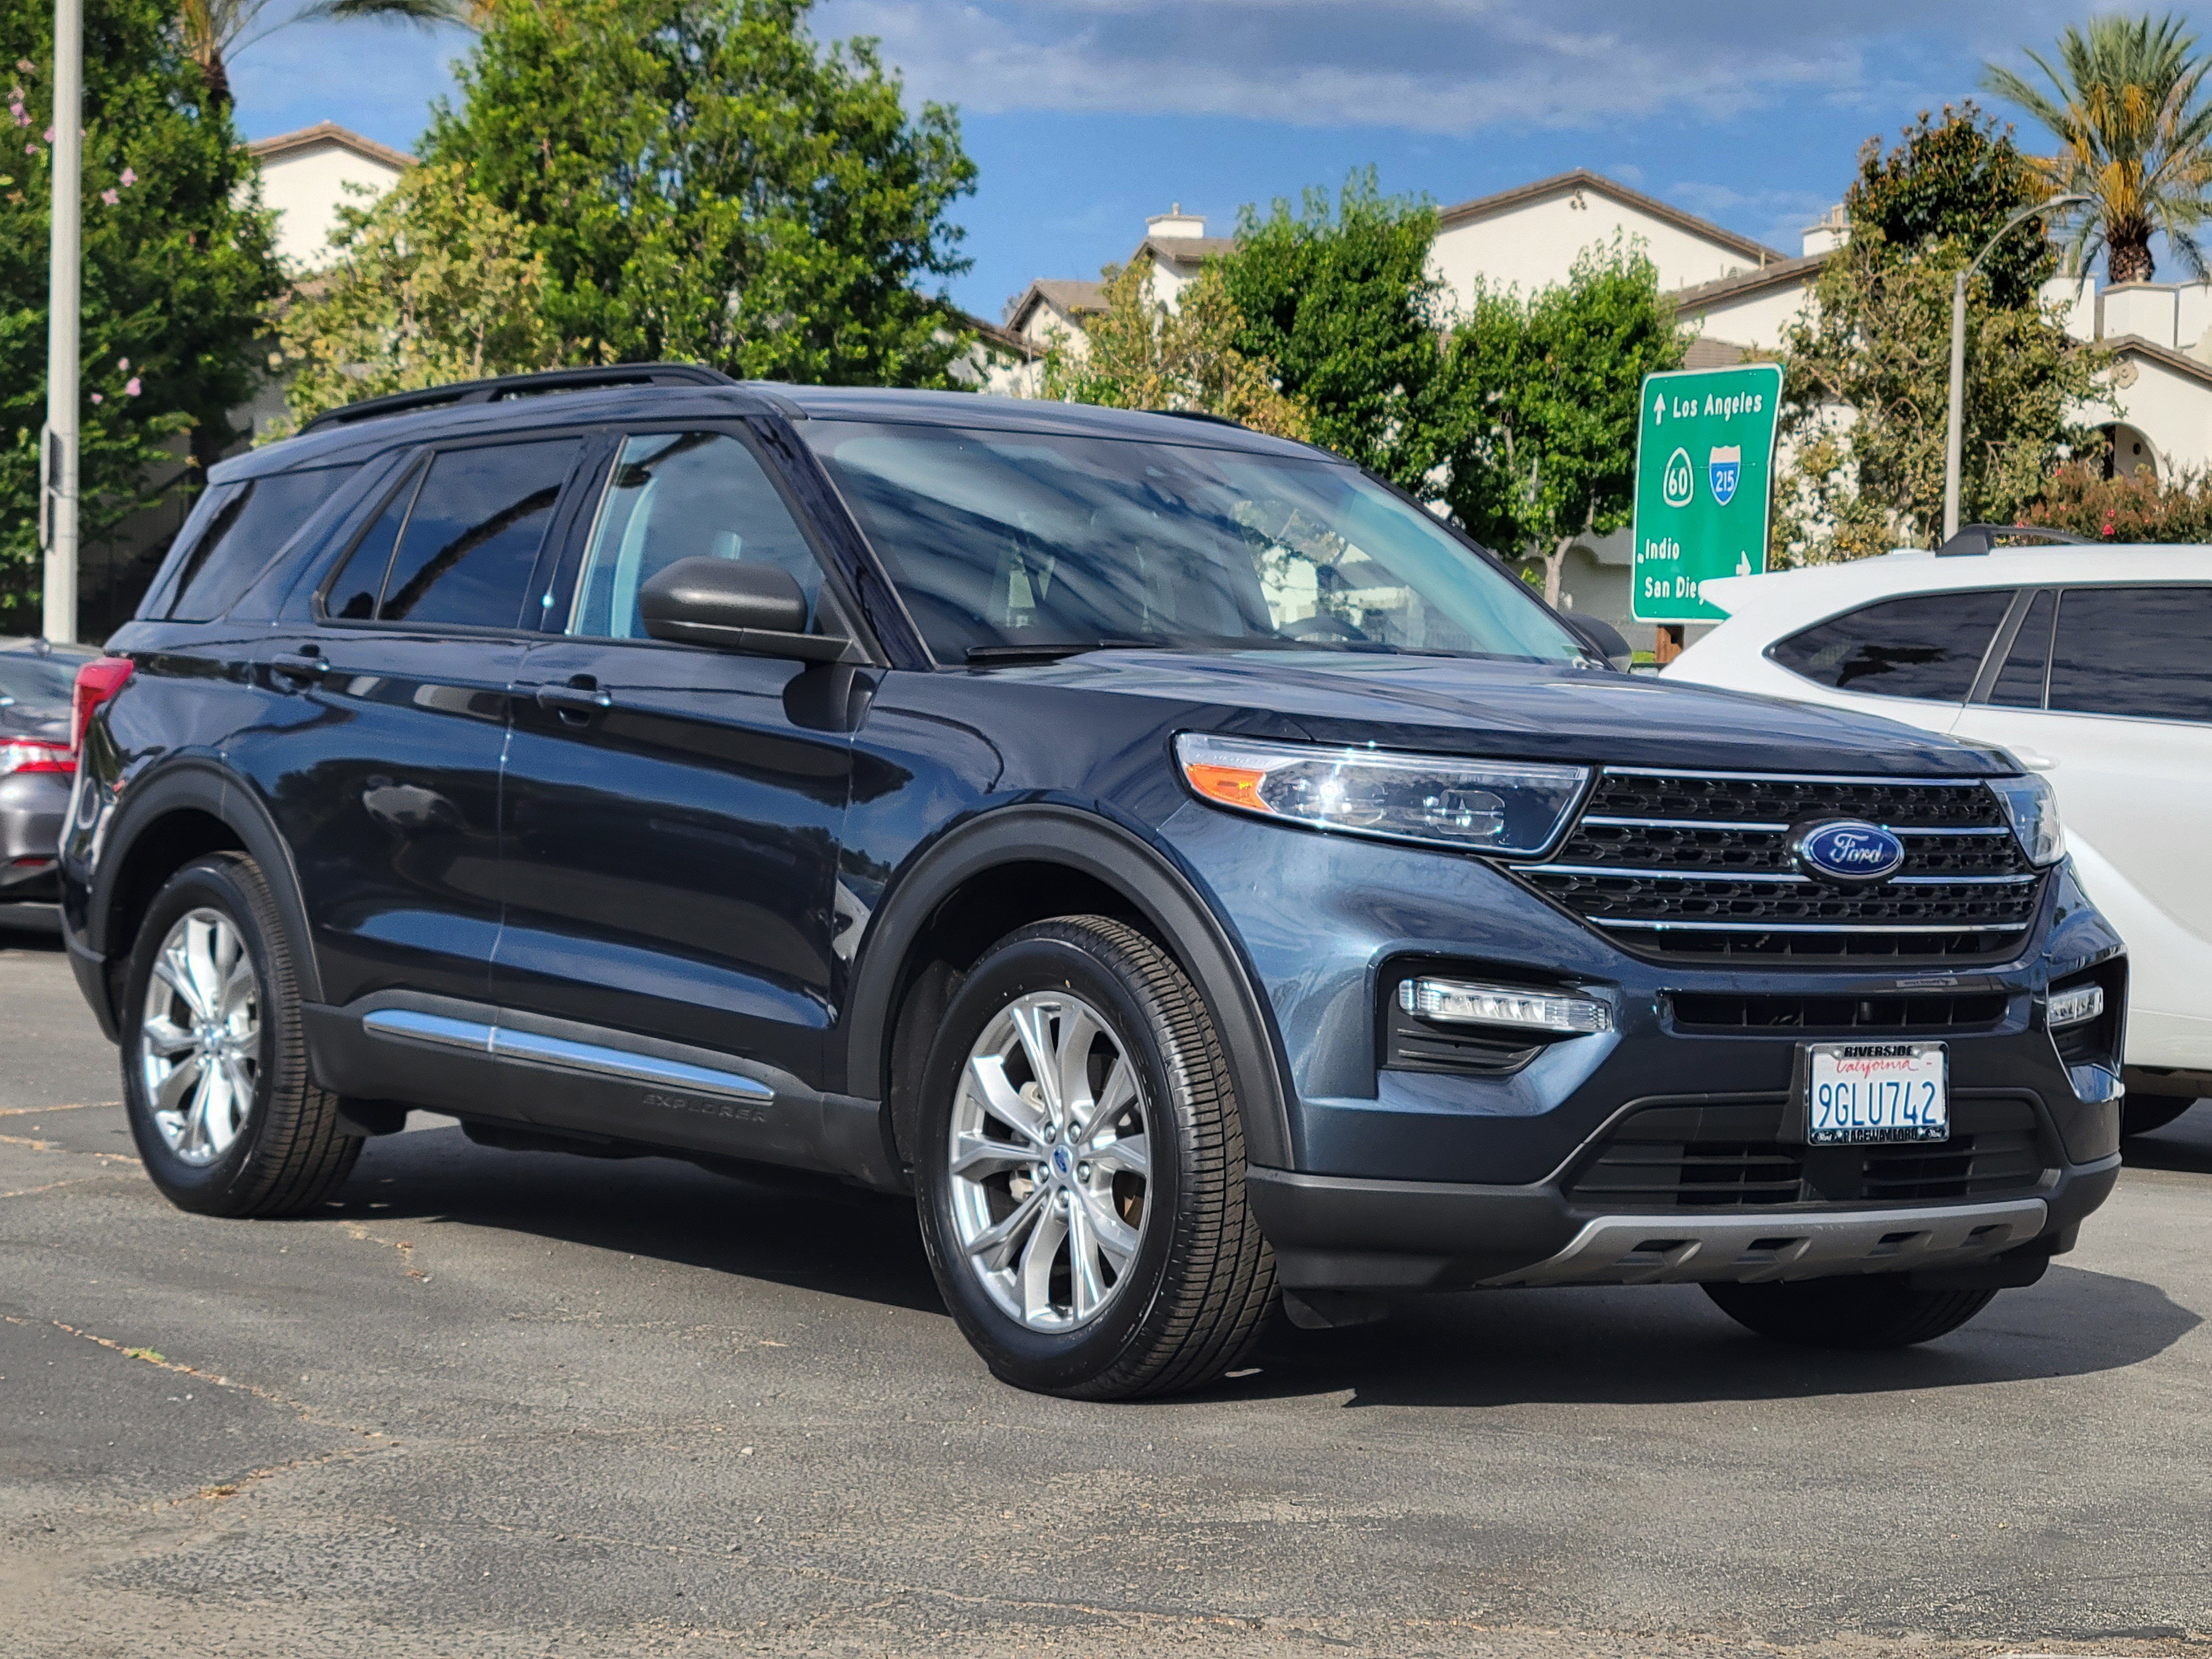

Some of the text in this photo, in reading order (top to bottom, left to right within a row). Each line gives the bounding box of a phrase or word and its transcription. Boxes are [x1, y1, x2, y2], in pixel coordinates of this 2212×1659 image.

[1673, 391, 1762, 421] Los Angeles
[1668, 467, 1688, 496] 60
[1716, 470, 1735, 492] 215
[1645, 537, 1680, 560] Indio
[1645, 576, 1705, 606] San Die
[1830, 833, 1883, 865] Ford
[1844, 1046, 1913, 1057] RIVERSIDE
[1836, 1059, 1918, 1078] California
[643, 1094, 766, 1122] EXPLORER
[1818, 1081, 1937, 1127] 9GLU742
